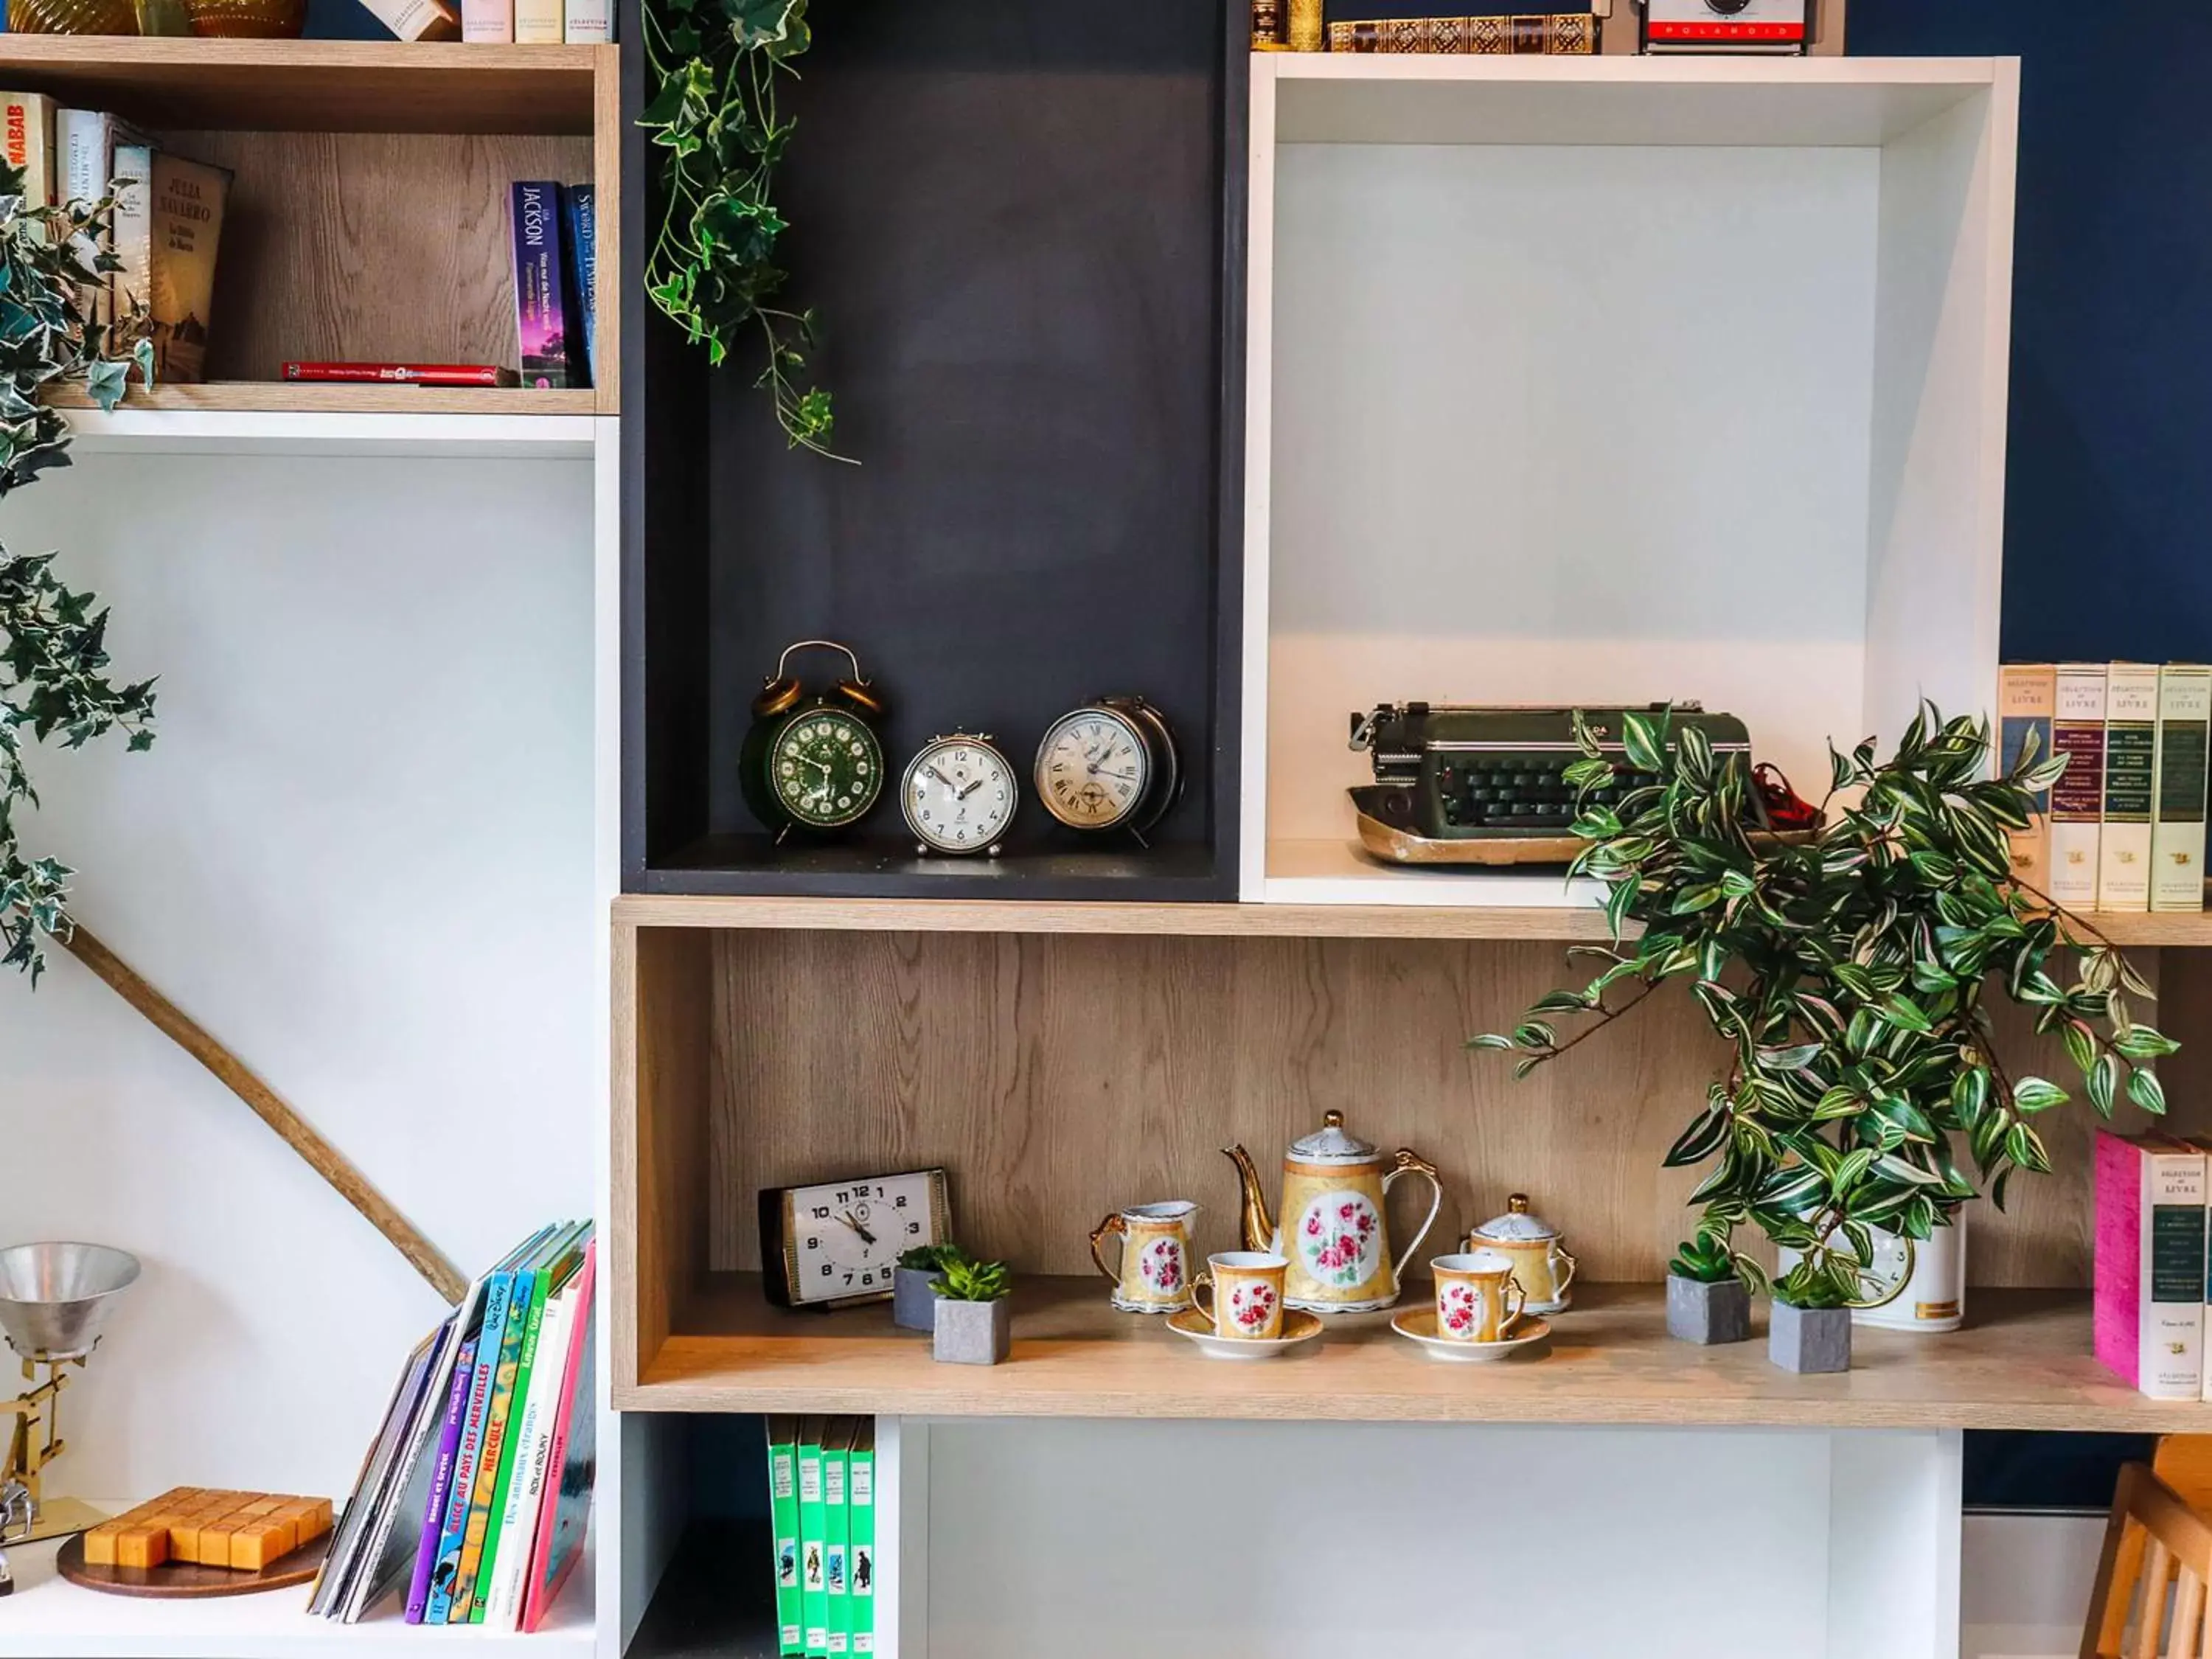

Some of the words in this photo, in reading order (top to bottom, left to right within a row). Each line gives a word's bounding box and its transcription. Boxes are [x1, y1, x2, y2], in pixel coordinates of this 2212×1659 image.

[1665, 27, 1787, 35] POLAROID
[7, 104, 27, 164] NABAB
[523, 186, 543, 246] JACKSON
[578, 195, 594, 239] SWORD
[542, 293, 550, 313] Nacht
[2170, 700, 2200, 709] LIVRE
[937, 756, 945, 766] 11
[955, 751, 967, 762] 12
[978, 757, 983, 767] 1
[917, 790, 925, 800] 9
[996, 790, 1004, 801] 3
[923, 810, 931, 820] 8
[990, 810, 998, 819] 4
[937, 824, 945, 833] 7
[956, 829, 964, 840] 6
[977, 824, 984, 834] 5
[836, 1192, 849, 1203] 11
[852, 1186, 869, 1197] 12
[877, 1186, 884, 1198] 1
[896, 1196, 907, 1207] 2
[812, 1206, 830, 1219] 10
[908, 1222, 920, 1234] 3
[807, 1237, 818, 1249] 9
[1896, 1251, 1905, 1262] 3
[821, 1265, 832, 1276] 8
[880, 1267, 891, 1279] 5
[843, 1273, 853, 1286] 7
[862, 1273, 873, 1285] 6
[488, 1285, 507, 1312] Disney
[469, 1363, 490, 1428] MERVEILLES
[465, 1432, 477, 1452] DES
[484, 1420, 503, 1472] HERCULE
[437, 1453, 450, 1482] Gretel
[459, 1453, 473, 1479] PAYS
[505, 1504, 518, 1525] Des
[512, 1453, 528, 1500] animaux
[524, 1402, 538, 1450] étranges
[436, 1483, 444, 1494] et
[457, 1481, 468, 1498] AU
[529, 1481, 540, 1495] ROX
[449, 1501, 465, 1533] ALICE
